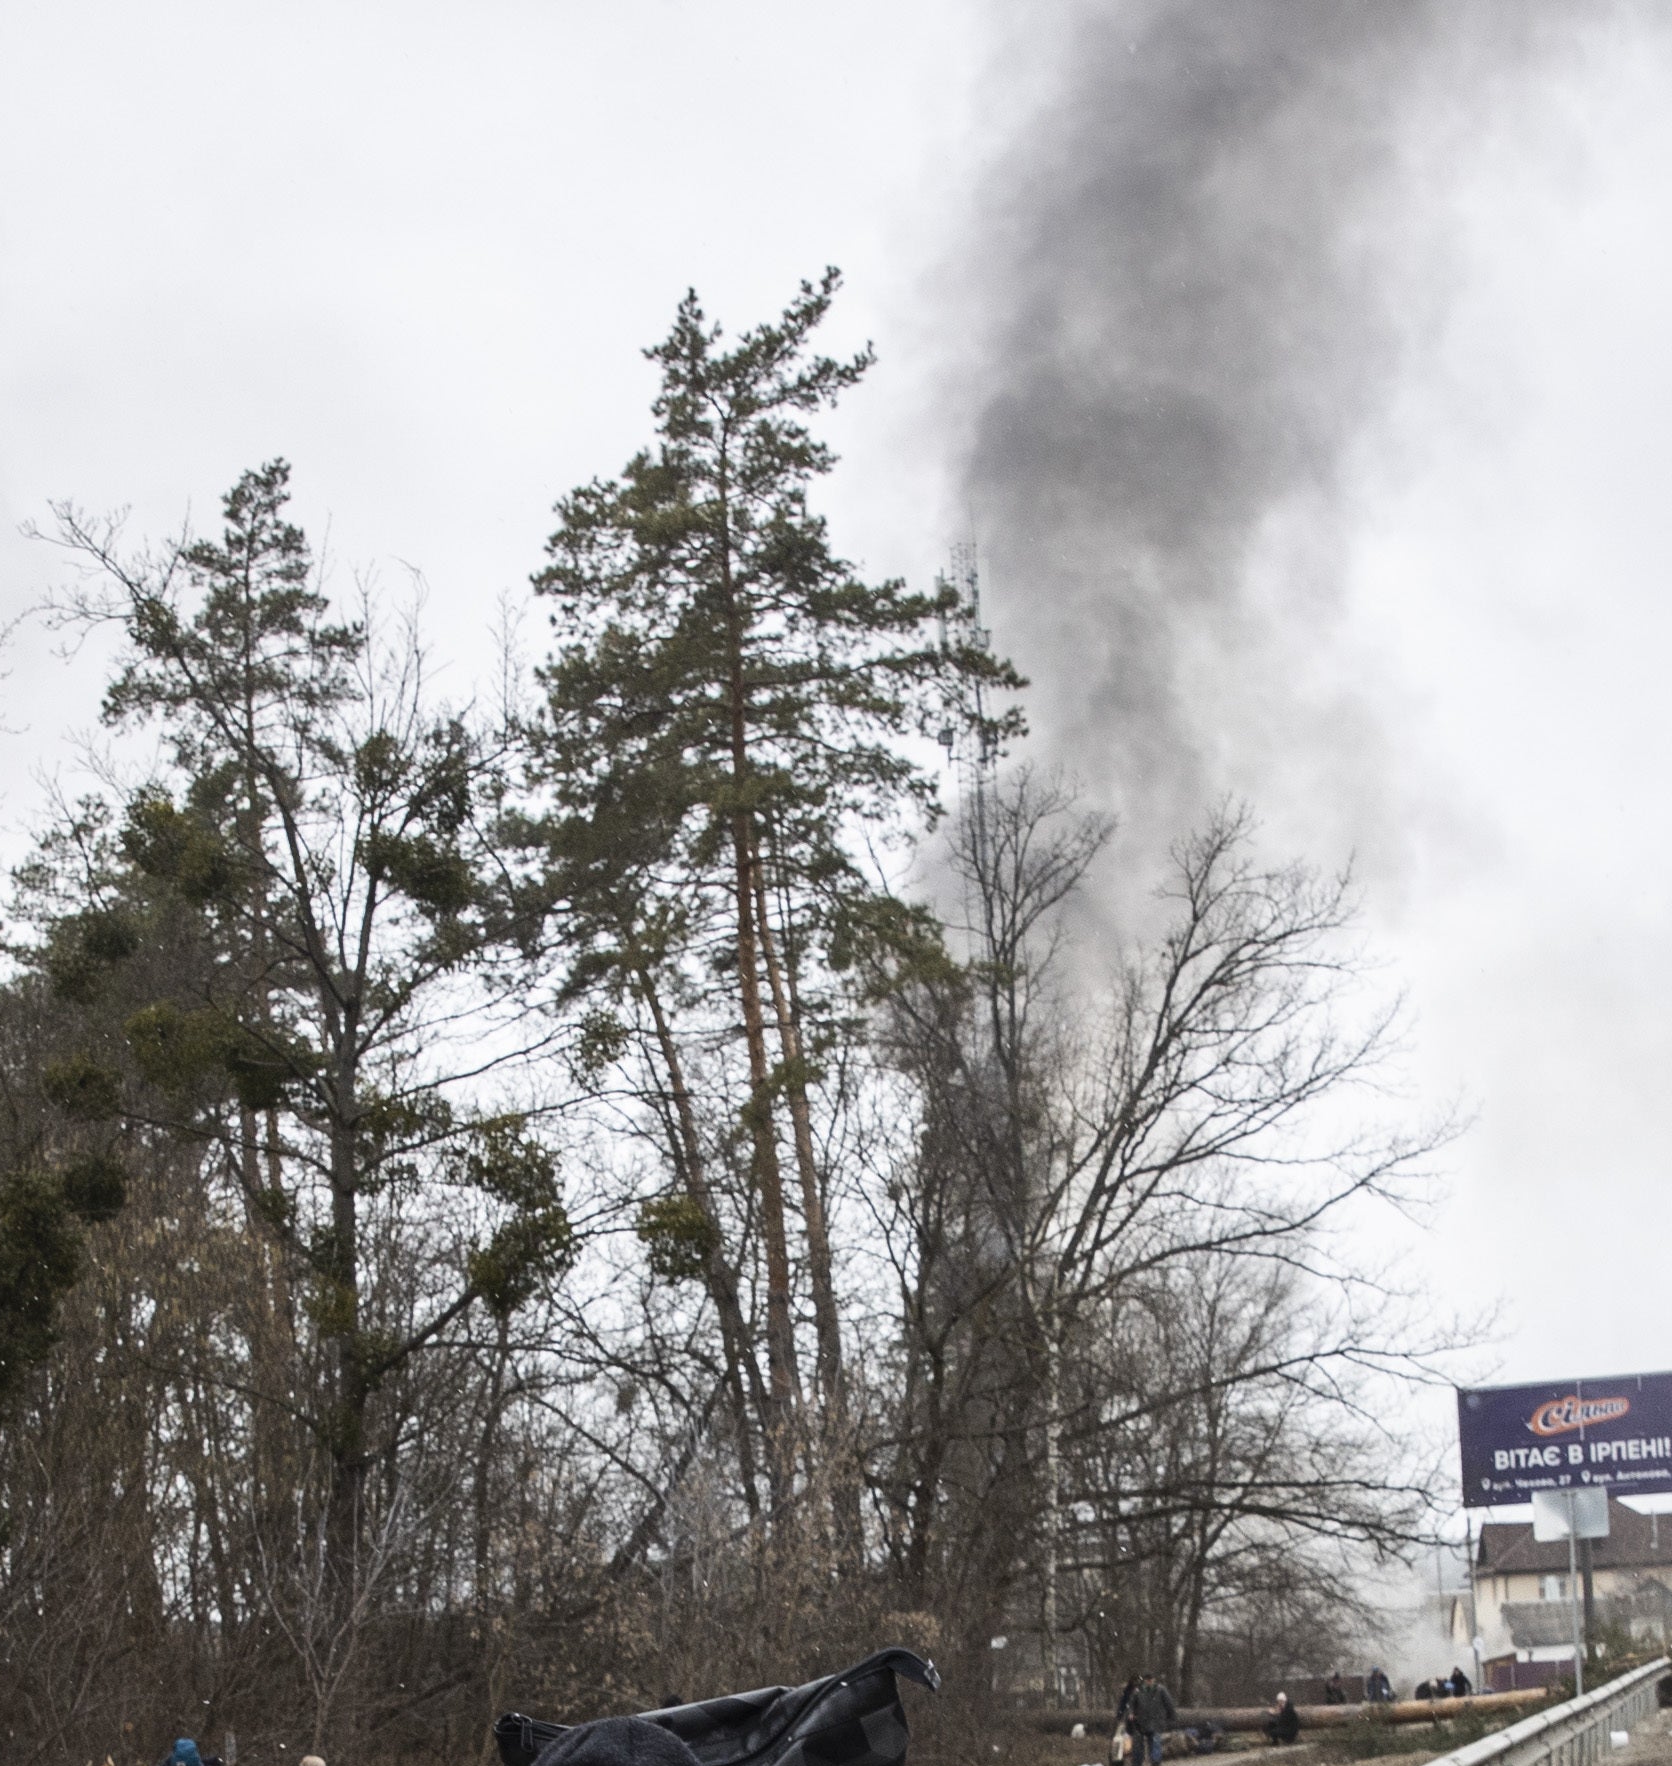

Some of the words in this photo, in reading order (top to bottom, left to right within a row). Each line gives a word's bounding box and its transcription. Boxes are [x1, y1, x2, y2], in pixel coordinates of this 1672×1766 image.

[1493, 1446, 1561, 1470] ВІТАЄ
[1567, 1443, 1584, 1465] В
[1589, 1436, 1672, 1463] ІРПЕНІ!
